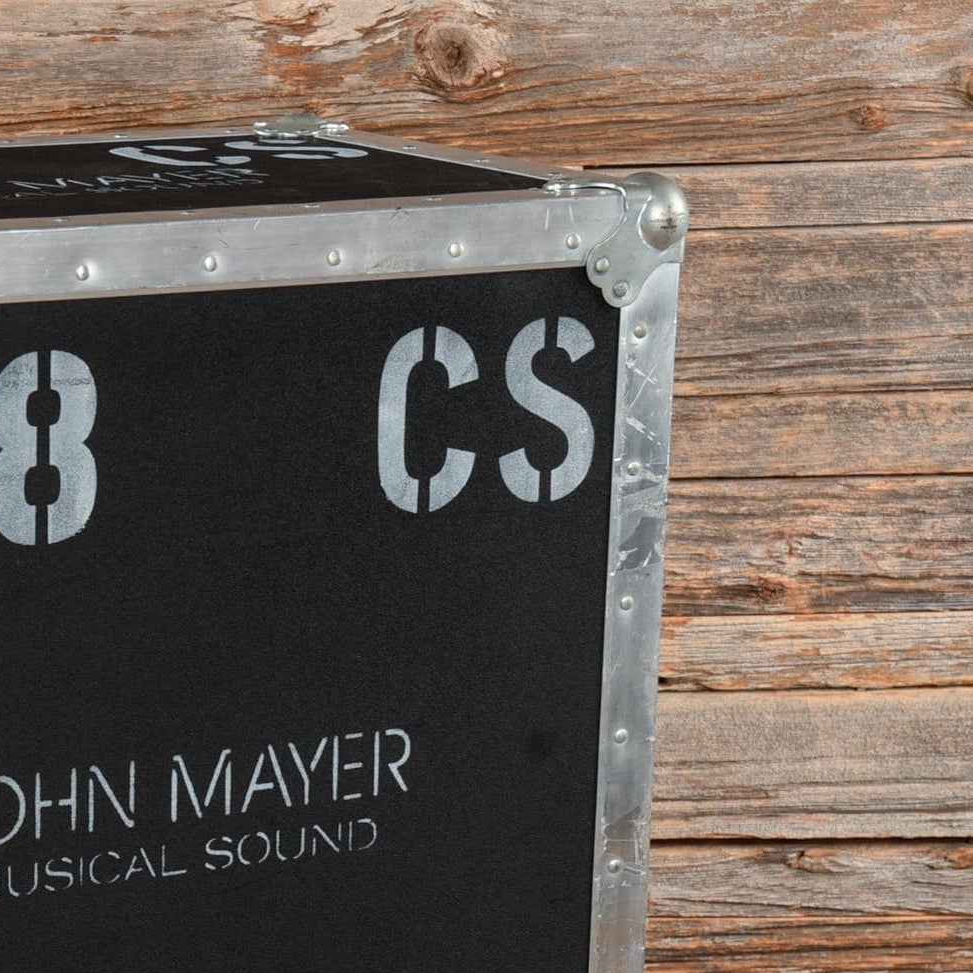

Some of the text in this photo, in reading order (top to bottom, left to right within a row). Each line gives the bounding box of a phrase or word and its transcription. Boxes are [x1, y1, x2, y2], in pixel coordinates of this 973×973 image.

[7, 168, 270, 188] MAYER
[111, 138, 369, 167] CS
[377, 316, 595, 514] CS
[170, 728, 411, 823] MAYER
[204, 817, 378, 871] SOUND
